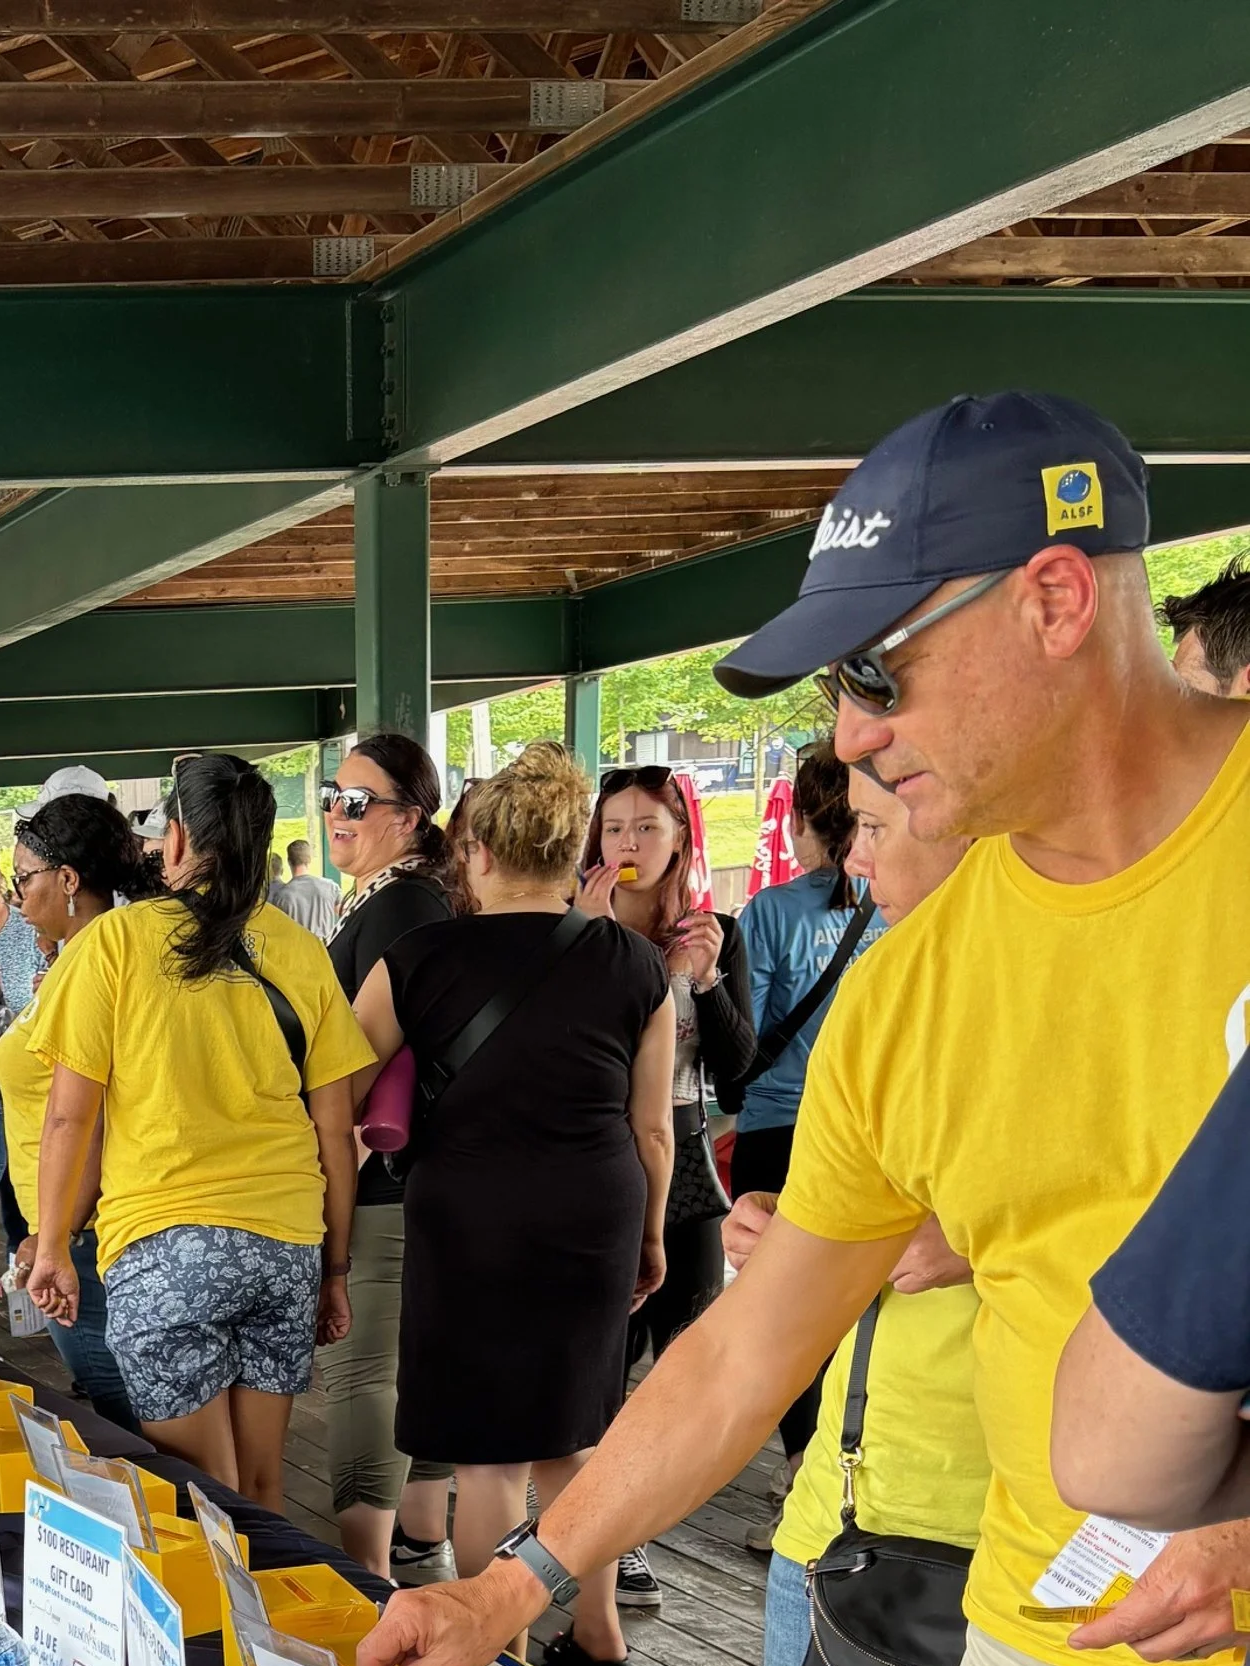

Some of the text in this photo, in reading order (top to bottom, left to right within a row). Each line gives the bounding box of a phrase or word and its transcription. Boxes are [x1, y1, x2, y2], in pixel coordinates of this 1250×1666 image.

[1060, 505, 1094, 520] ALSF
[37, 1525, 111, 1578] $100 RESTURANT
[50, 1565, 94, 1602] GIFT CARD
[1049, 1570, 1066, 1585] the
[34, 1626, 57, 1653] BLUE
